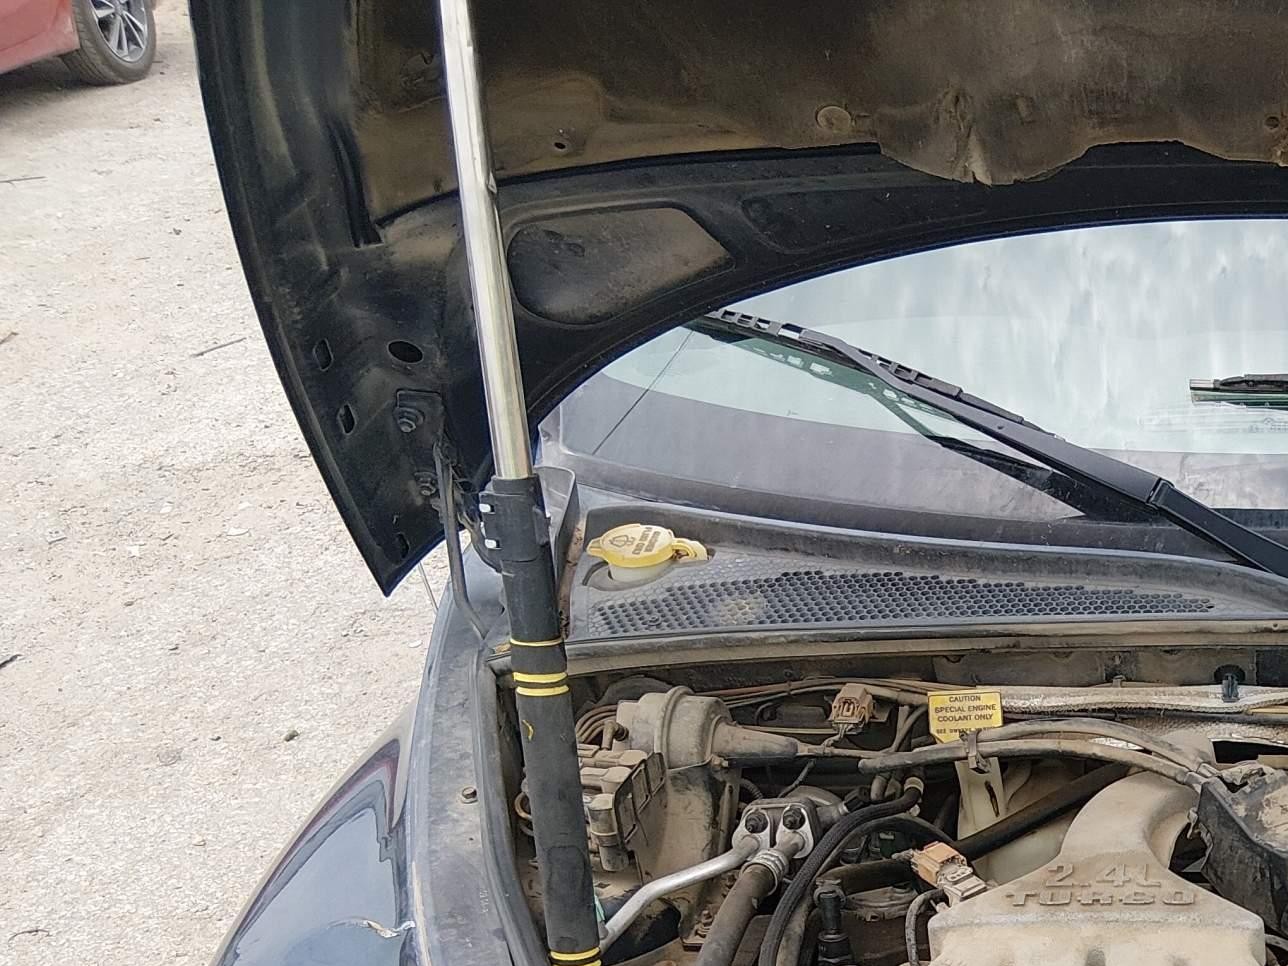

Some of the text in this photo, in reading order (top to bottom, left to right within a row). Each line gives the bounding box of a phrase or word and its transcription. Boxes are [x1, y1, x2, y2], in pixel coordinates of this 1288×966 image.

[949, 695, 981, 703] CAUTION
[934, 703, 997, 714] SPECIAL ENGINE
[937, 713, 993, 722] COOLANT ONLY
[1045, 863, 1162, 888] 2.4L
[1006, 889, 1196, 906] TURBO
